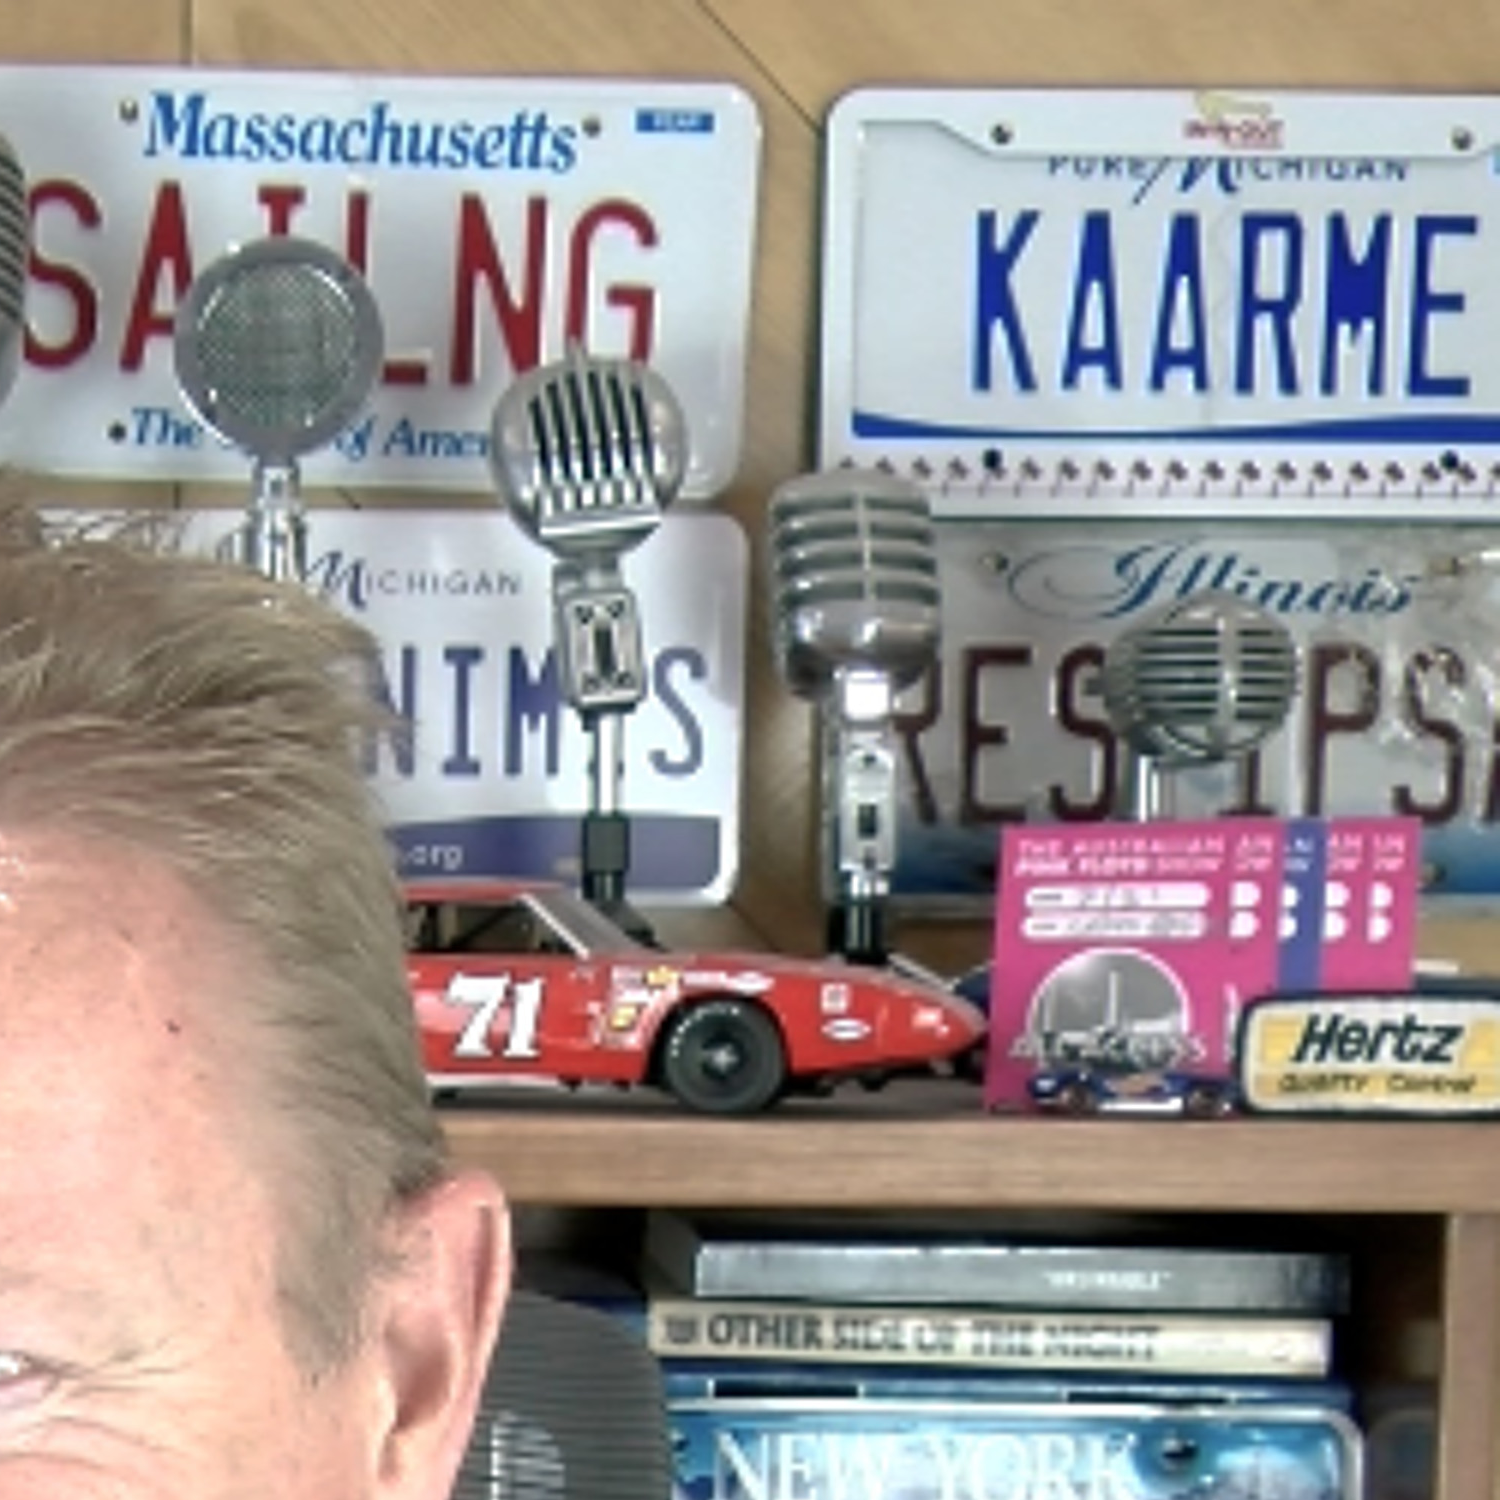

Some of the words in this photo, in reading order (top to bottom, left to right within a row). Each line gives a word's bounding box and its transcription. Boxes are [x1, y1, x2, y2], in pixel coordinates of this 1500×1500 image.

[142, 91, 578, 174] Massachusetts
[972, 210, 1479, 397] KAARME
[132, 407, 199, 448] The
[1008, 536, 1420, 619] Illinois
[894, 645, 1118, 823] RES
[444, 970, 545, 1060] 71
[1289, 1013, 1465, 1063] Hertz
[706, 1312, 825, 1350] OTHER
